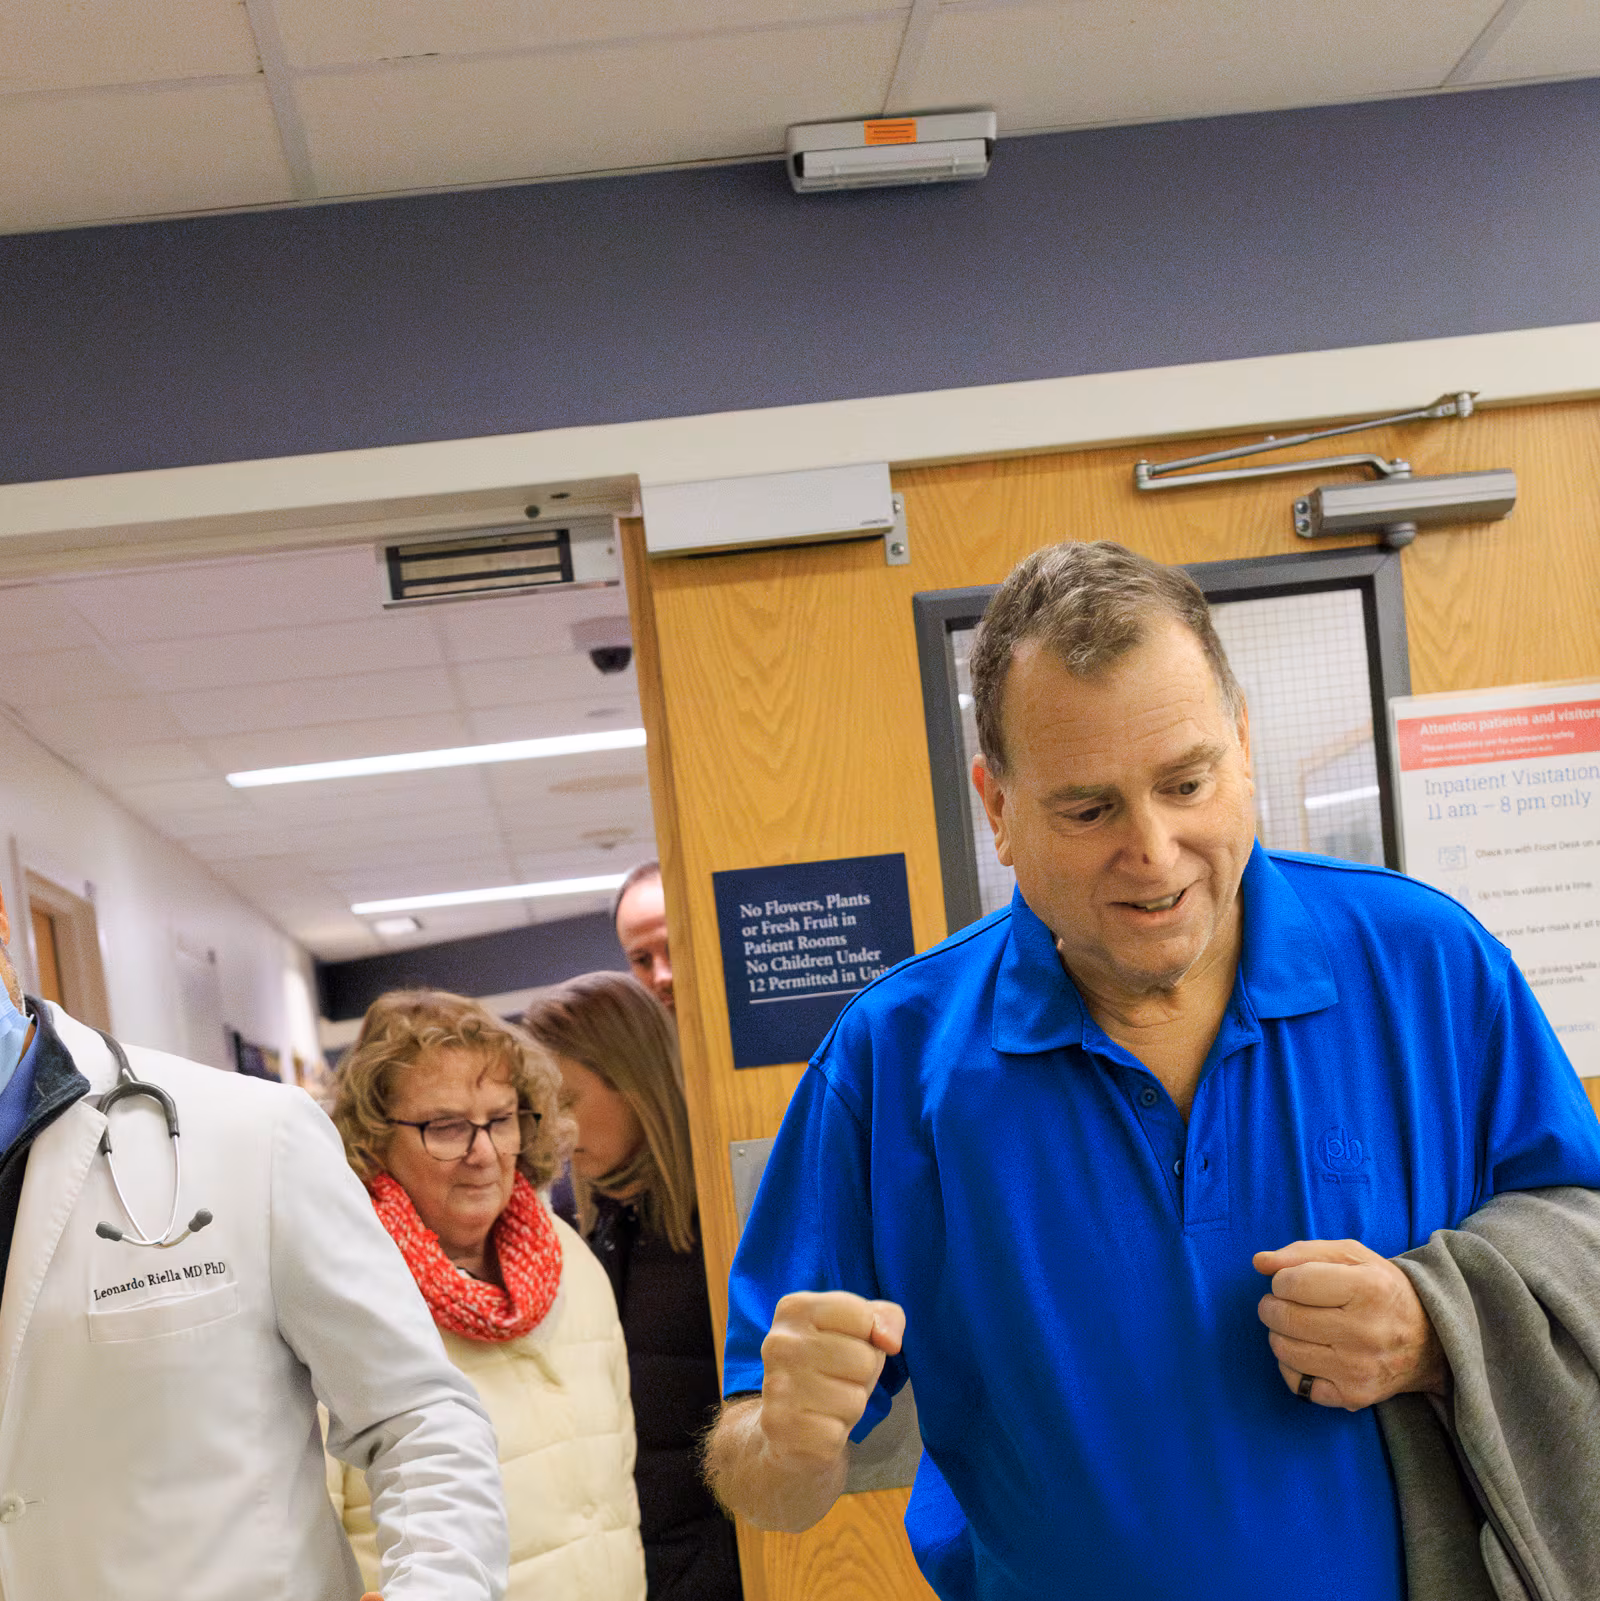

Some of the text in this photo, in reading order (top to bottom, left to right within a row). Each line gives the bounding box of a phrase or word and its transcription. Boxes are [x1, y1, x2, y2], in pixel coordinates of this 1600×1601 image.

[1420, 721, 1477, 737] Attention
[1479, 716, 1529, 733] patients
[1532, 710, 1555, 724] and
[1425, 765, 1600, 797] Inpatient Visitation
[1428, 804, 1442, 820] 11
[1448, 802, 1477, 817] am
[1500, 796, 1511, 813] 8
[1517, 795, 1546, 816] pm
[1551, 788, 1592, 809] only
[1475, 848, 1502, 858] Check
[1559, 839, 1581, 850] Desk
[1521, 885, 1552, 895] visitors
[739, 893, 871, 919] No Flowers, Plants
[741, 912, 857, 938] or Fresh Fruit in
[1506, 927, 1524, 938] your
[1526, 924, 1545, 934] face
[1547, 922, 1570, 932] mask
[744, 933, 848, 956] Patient Rooms
[745, 948, 881, 976] No Children Under
[748, 963, 891, 994] 12 Permitted in Uni
[93, 1261, 226, 1302] Leonardo Riella MD PhD
